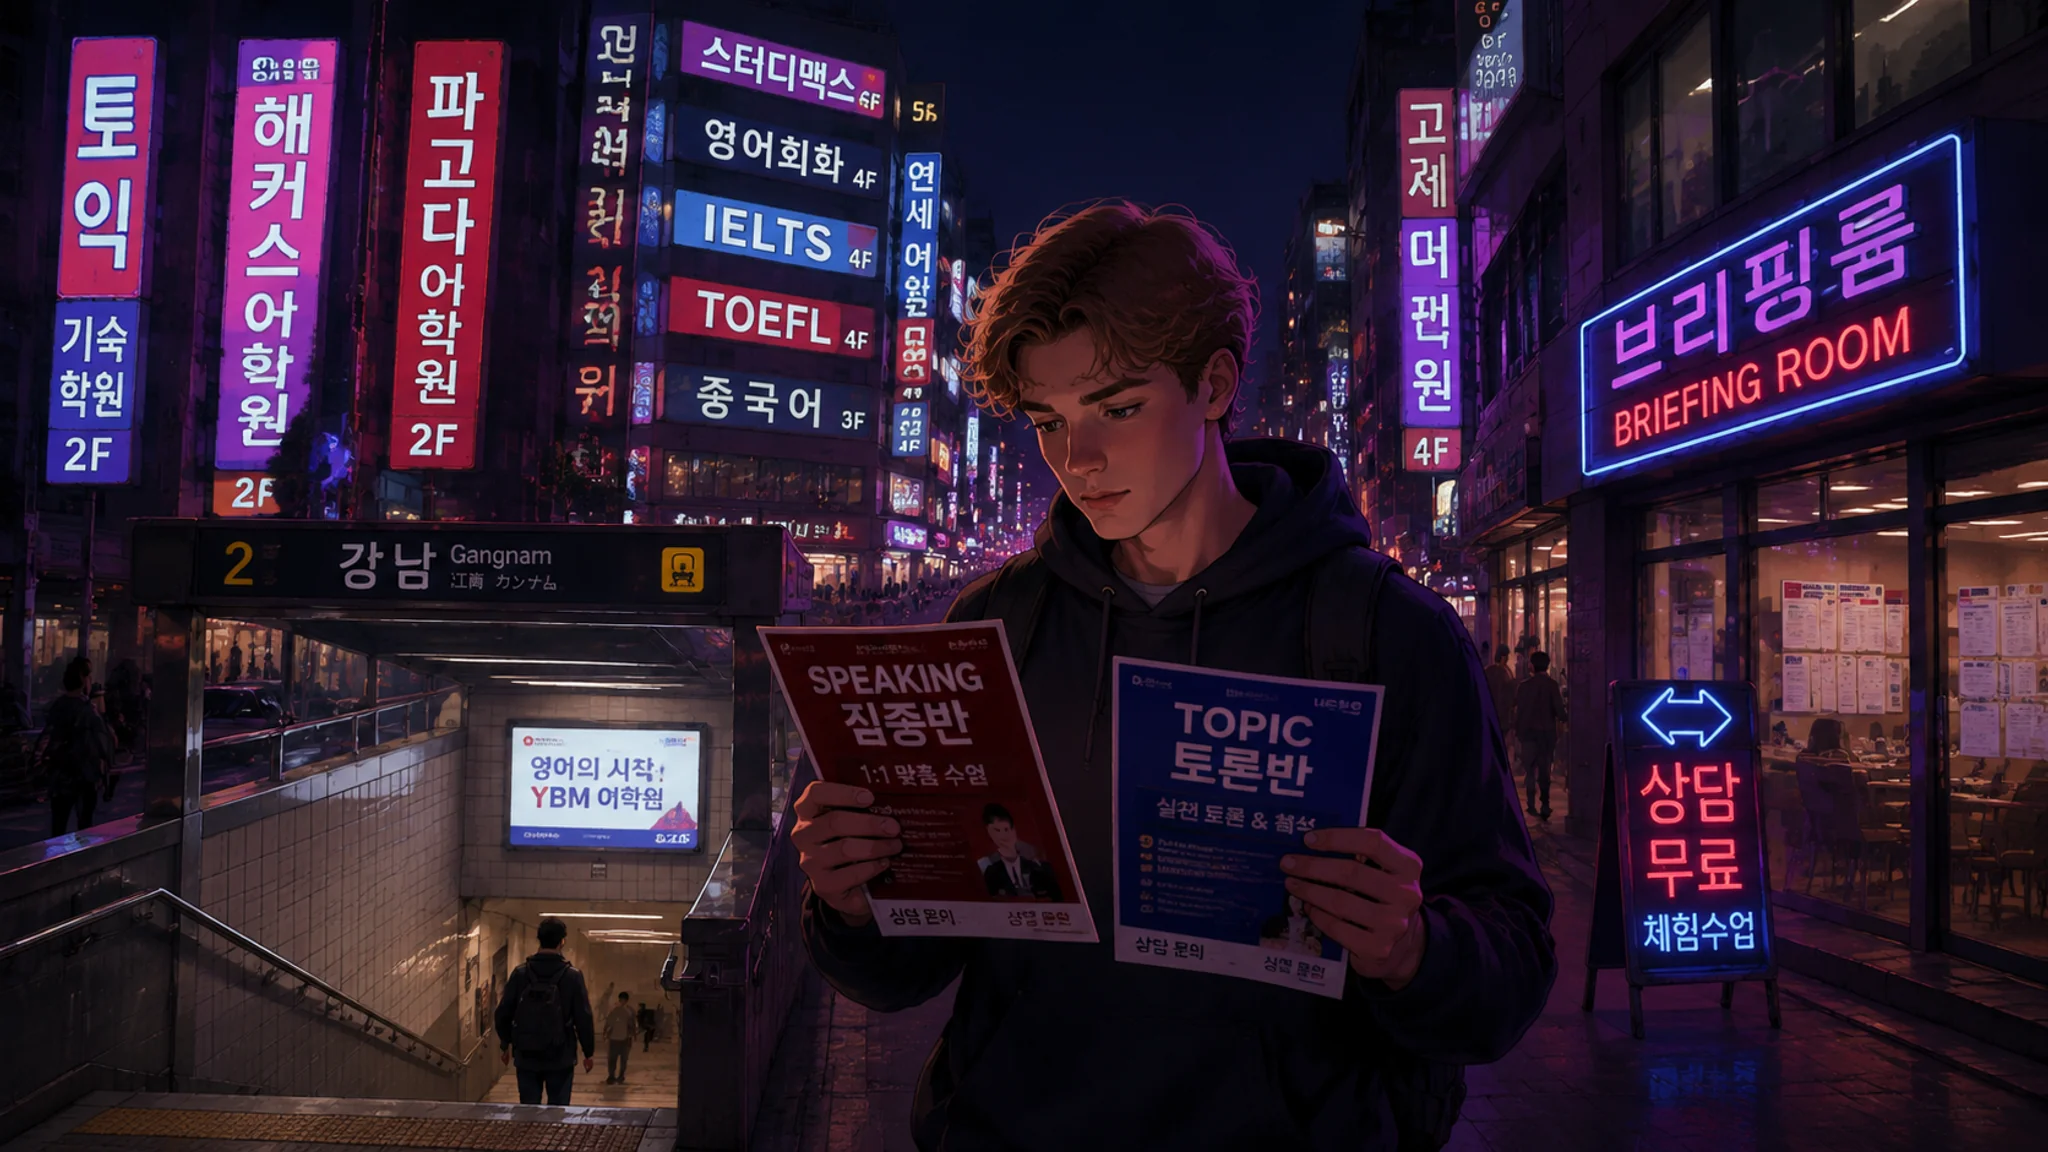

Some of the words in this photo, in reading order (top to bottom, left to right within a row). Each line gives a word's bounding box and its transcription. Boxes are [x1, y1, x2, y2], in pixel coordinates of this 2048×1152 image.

[701, 37, 855, 103] 스터디맥스
[73, 75, 138, 271] 토익
[705, 119, 844, 184] 영어회화
[852, 168, 877, 189] 4F
[1408, 103, 1447, 208] 고제
[414, 72, 484, 405] 파고다어학원
[704, 203, 832, 263] IELTS
[848, 249, 872, 269] 4F
[1611, 184, 1915, 390] 브리핑룸
[60, 316, 128, 364] 기숙
[697, 290, 832, 346] TOEFL
[844, 330, 868, 350] 4F
[60, 370, 123, 419] 학원
[1614, 362, 1761, 448] BRIEFING
[1776, 306, 1911, 393] ROOM
[697, 375, 821, 429] 중국어
[841, 411, 866, 430] 3F
[64, 438, 113, 472] 2F
[409, 424, 458, 456] 2F
[1413, 437, 1449, 466] 4F
[232, 477, 277, 508] 2F
[223, 540, 254, 586] 2
[339, 541, 438, 590] 강남
[450, 543, 552, 569] Gangnam
[807, 661, 984, 695] SPEAKING
[1173, 701, 1314, 748] TOPIC
[531, 756, 600, 781] 영어의
[860, 763, 891, 785] 1:1
[1169, 740, 1315, 798] 토론반
[531, 786, 590, 809] YBM
[1640, 762, 1741, 825] 상담
[1647, 838, 1743, 899] 무료
[1643, 911, 1756, 953] 체험수업
